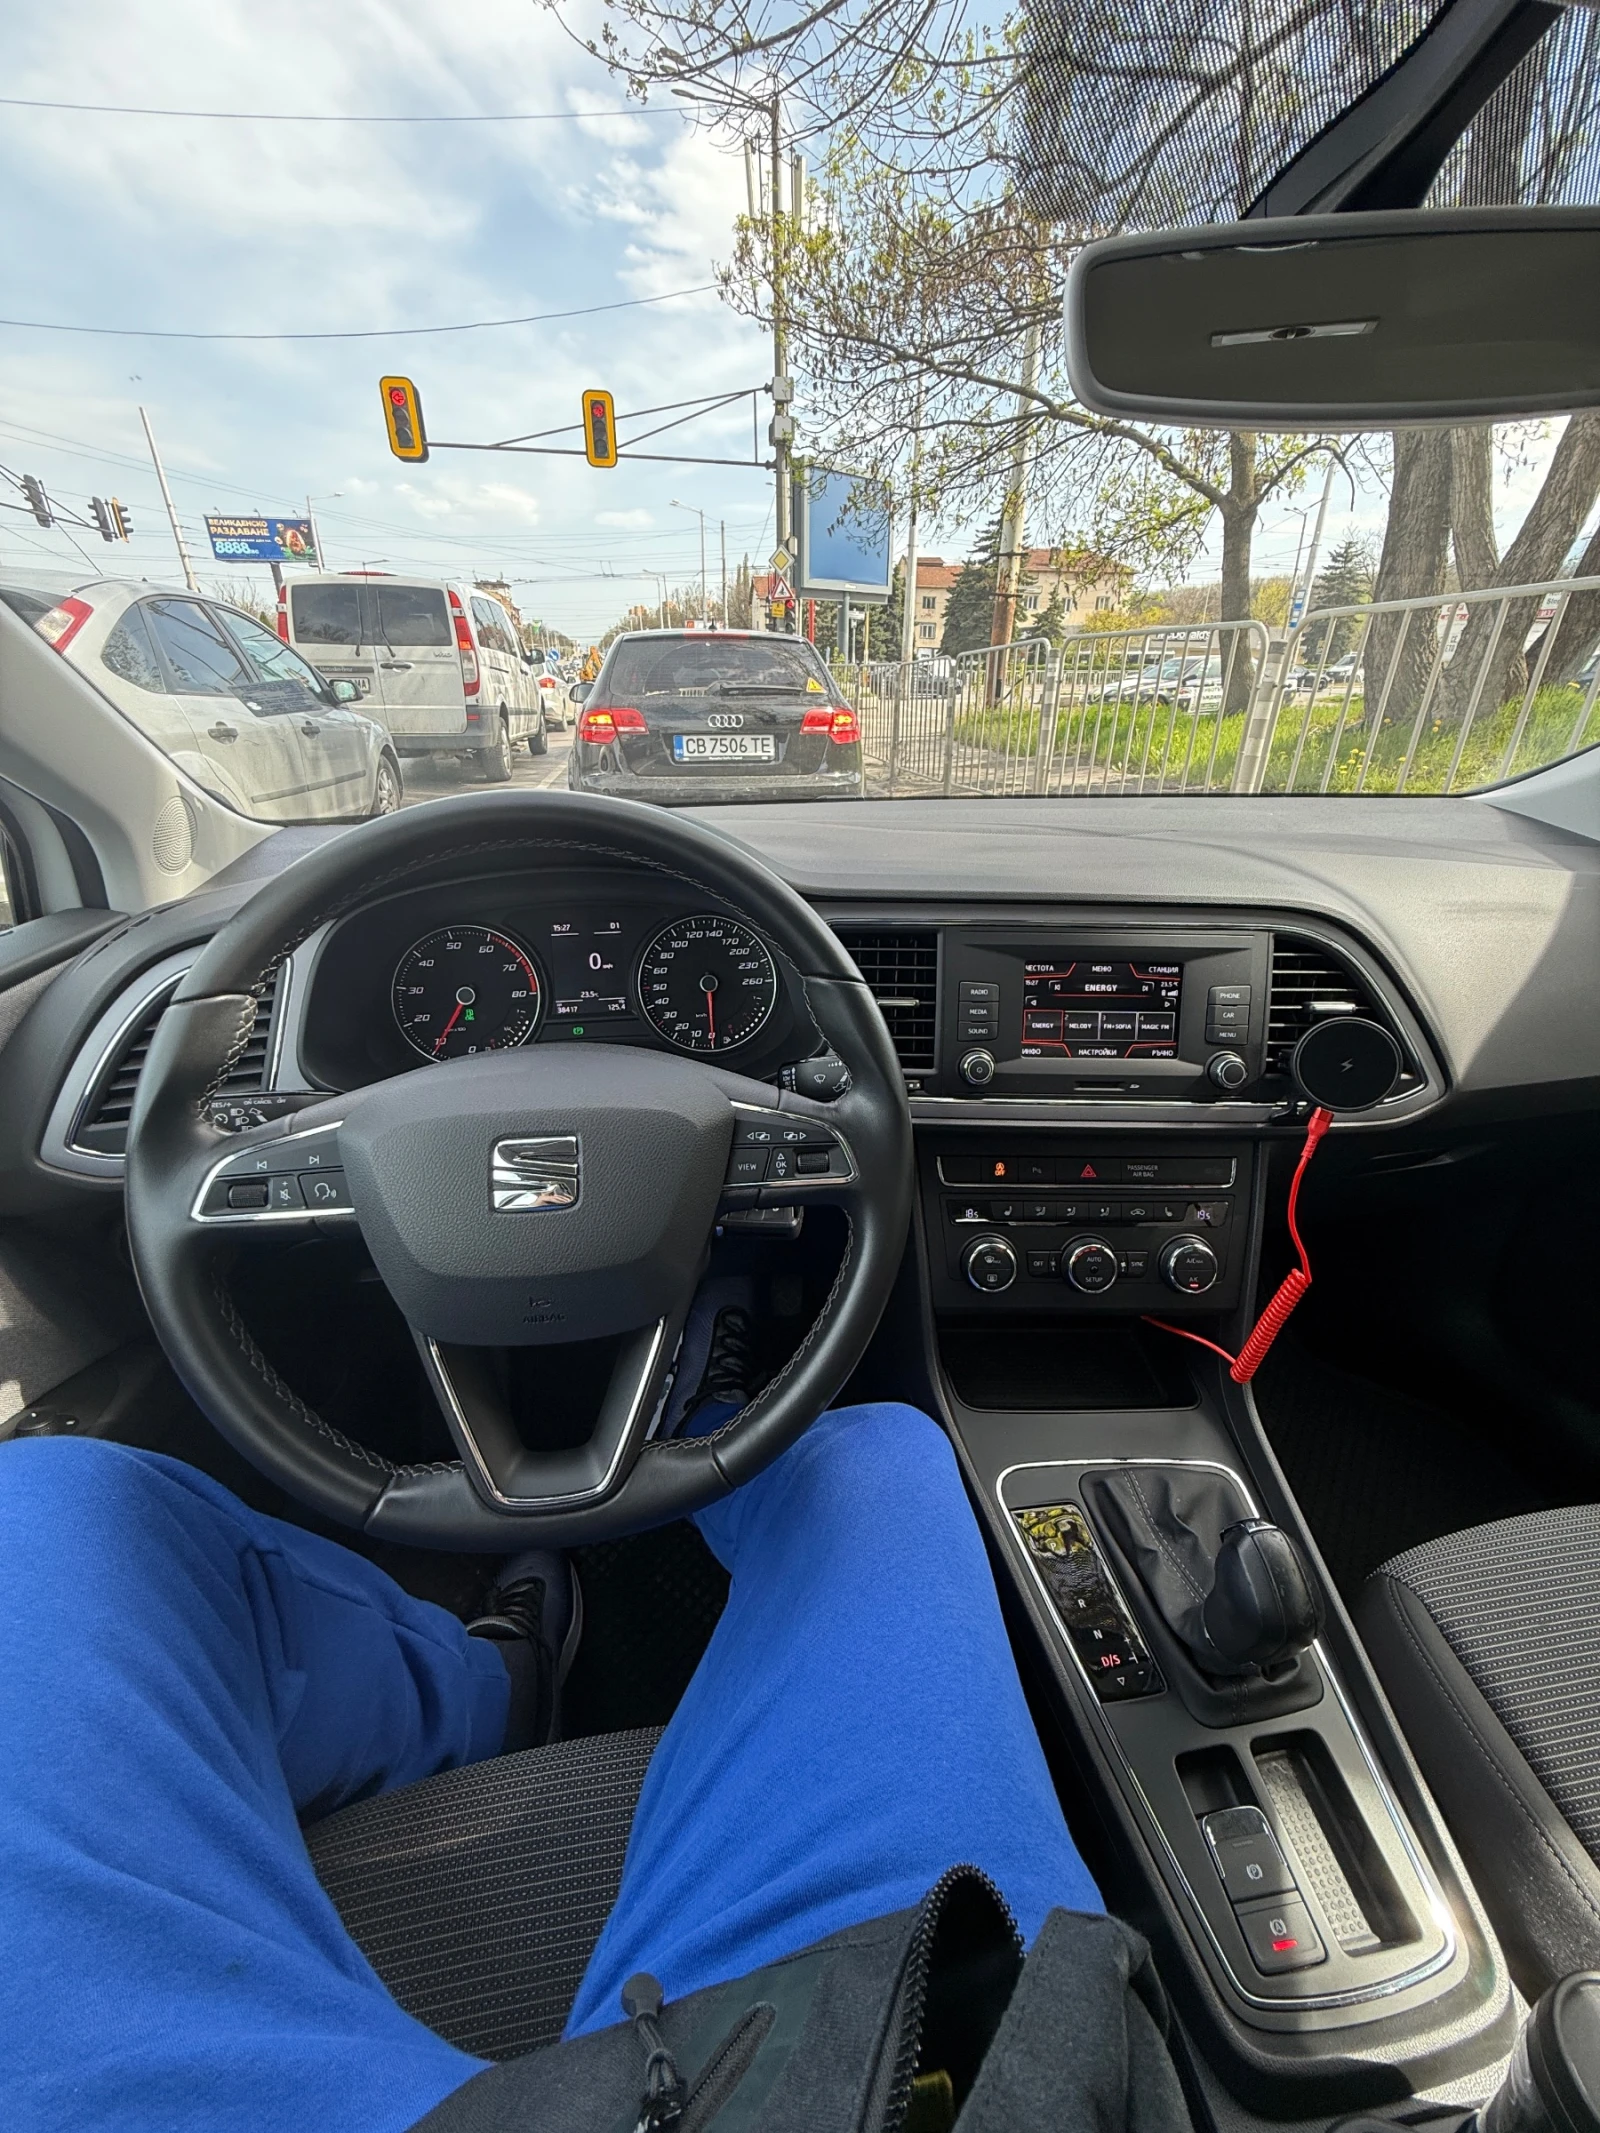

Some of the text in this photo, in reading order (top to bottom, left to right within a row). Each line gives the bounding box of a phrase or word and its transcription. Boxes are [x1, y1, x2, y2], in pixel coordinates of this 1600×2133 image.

[210, 526, 270, 536] РАЗДАВАНЕ
[686, 738, 771, 754] CB 7506 TE
[685, 931, 703, 939] 120
[704, 930, 723, 938] 140
[446, 942, 462, 950] 50
[721, 938, 739, 946] 170
[479, 945, 494, 953] 60
[729, 948, 750, 956] 200
[660, 952, 675, 960] 80
[418, 959, 434, 967] 40
[589, 952, 602, 970] 0
[502, 963, 517, 972] 70
[738, 962, 759, 970] 230
[1148, 966, 1179, 974] СТАНЦИЯ
[653, 967, 668, 975] 60
[742, 978, 763, 986] 260
[408, 986, 424, 995] 30
[652, 983, 668, 991] 50
[1084, 984, 1118, 992] ENERGY
[511, 990, 527, 998] 80
[654, 997, 669, 1005] 40
[608, 1003, 626, 1011] 125.4
[414, 1014, 431, 1022] 20
[662, 1011, 678, 1019] 30
[674, 1022, 689, 1030] 20
[690, 1030, 702, 1038] 10
[468, 1045, 477, 1054] 0
[1078, 1047, 1117, 1056] НАСТРОЙКИ
[737, 1163, 757, 1171] VIEW
[775, 1160, 788, 1169] OK
[1078, 1599, 1087, 1609] R
[1093, 1629, 1103, 1640] N
[1101, 1653, 1121, 1667] D/S
